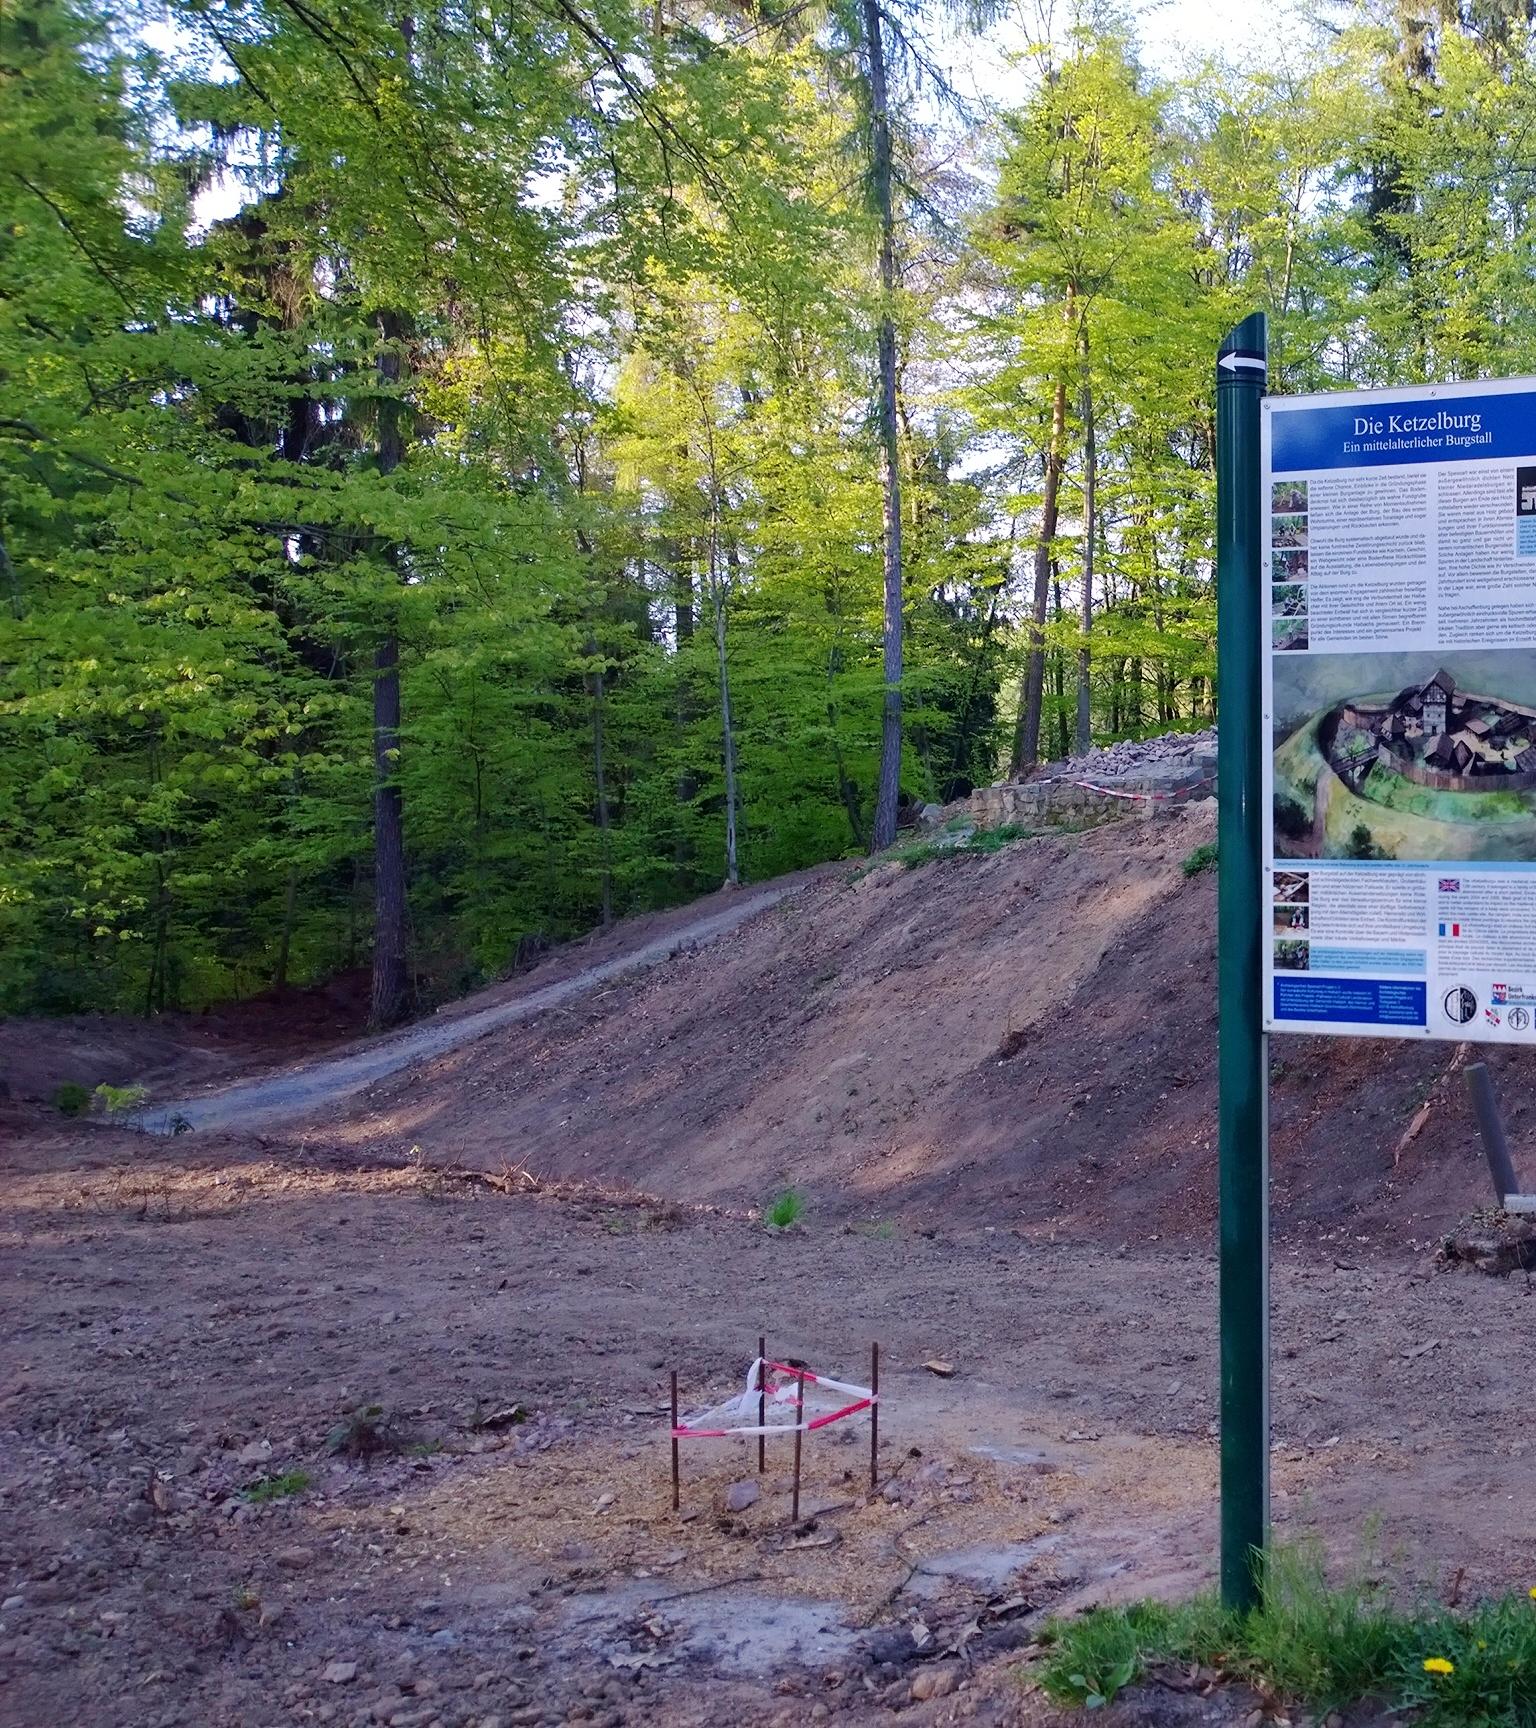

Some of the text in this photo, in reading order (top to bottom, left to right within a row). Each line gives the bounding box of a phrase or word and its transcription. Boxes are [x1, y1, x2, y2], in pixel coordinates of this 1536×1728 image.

[1354, 411, 1482, 436] Die Ketzelburg
[1343, 432, 1492, 453] Ein mittelalterlicher Burgstall
